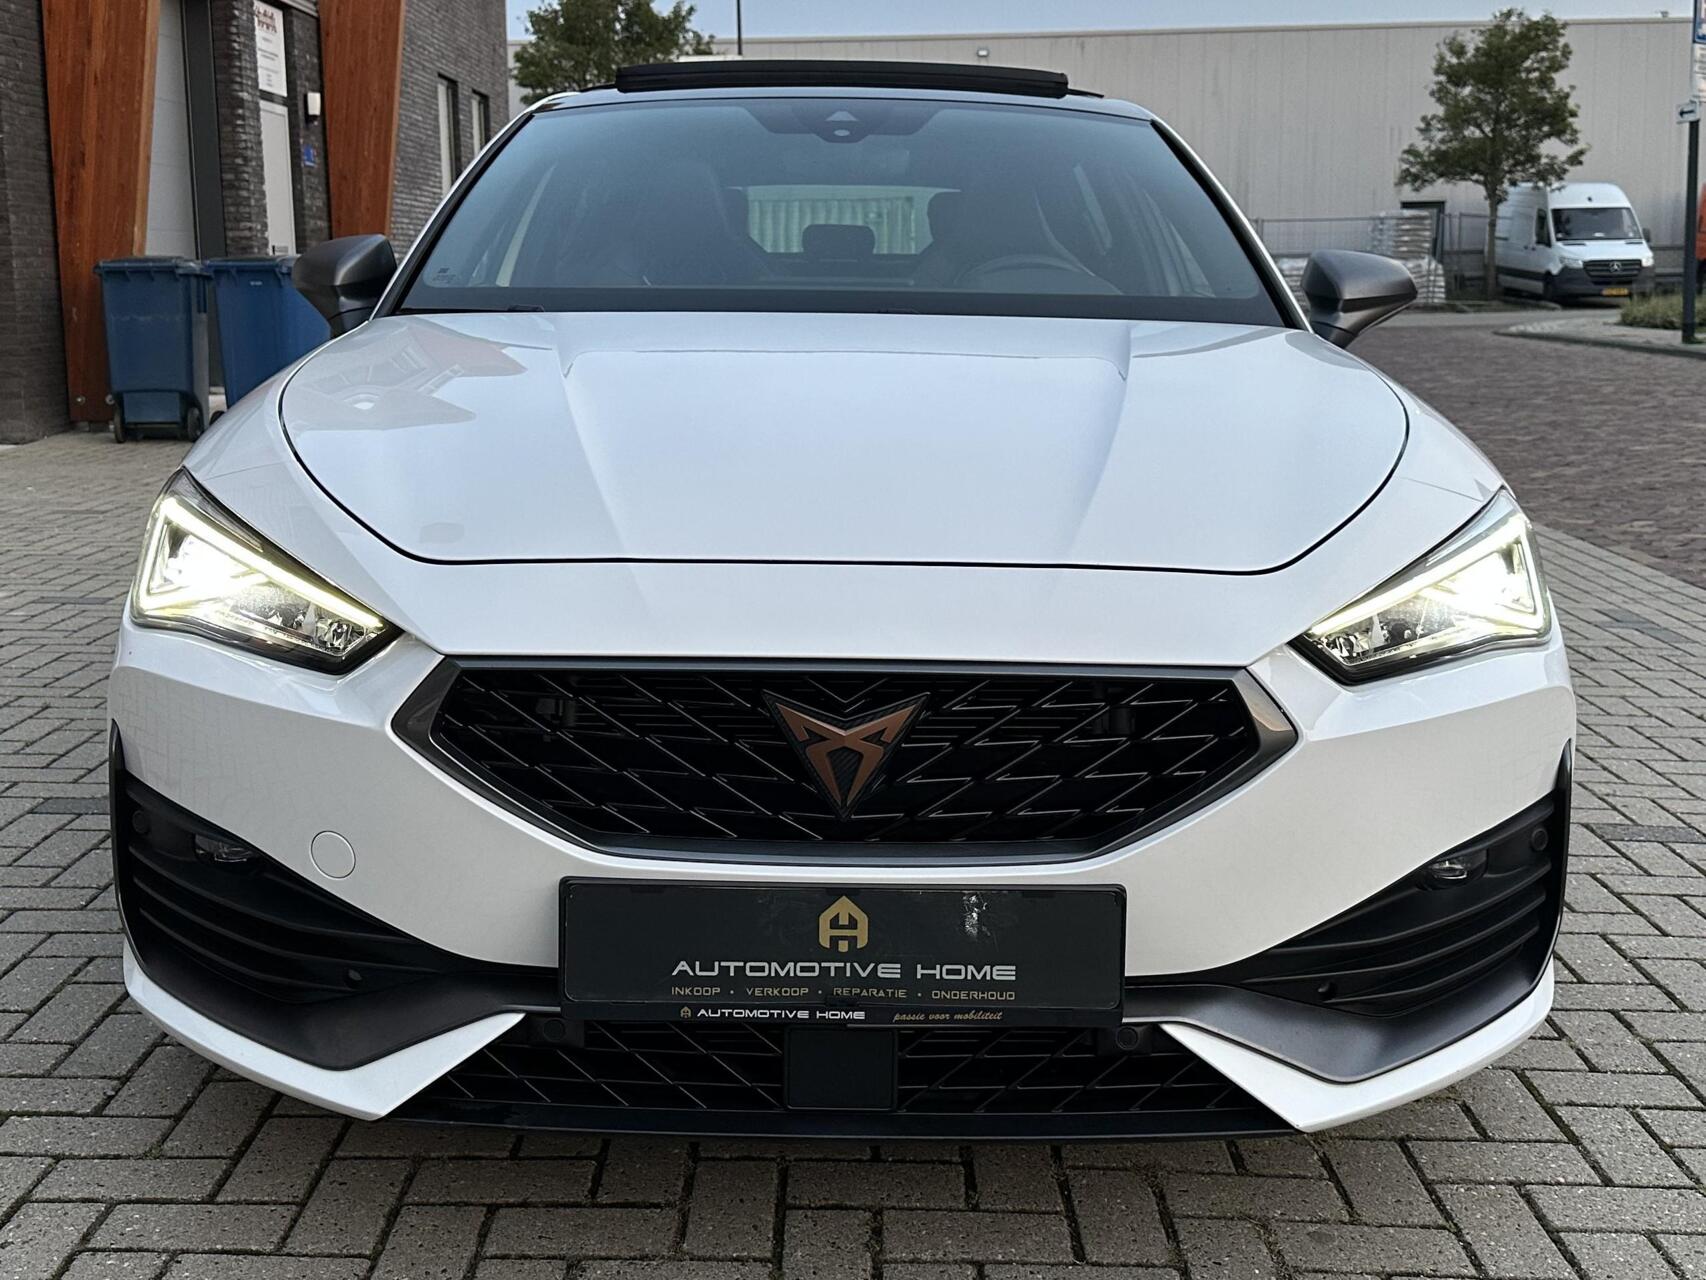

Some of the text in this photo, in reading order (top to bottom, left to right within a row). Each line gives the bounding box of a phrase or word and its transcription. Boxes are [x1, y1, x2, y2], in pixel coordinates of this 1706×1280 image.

[671, 960, 1016, 981] AUTOMOTIVE HOME
[671, 986, 1016, 1001] INKOOP VERKOOP REPARATIE ONDERHOUD
[697, 1008, 866, 1020] AUTOMOTIVE HOME
[892, 1012, 925, 1023] passie
[953, 1010, 1003, 1021] mobiliteit
